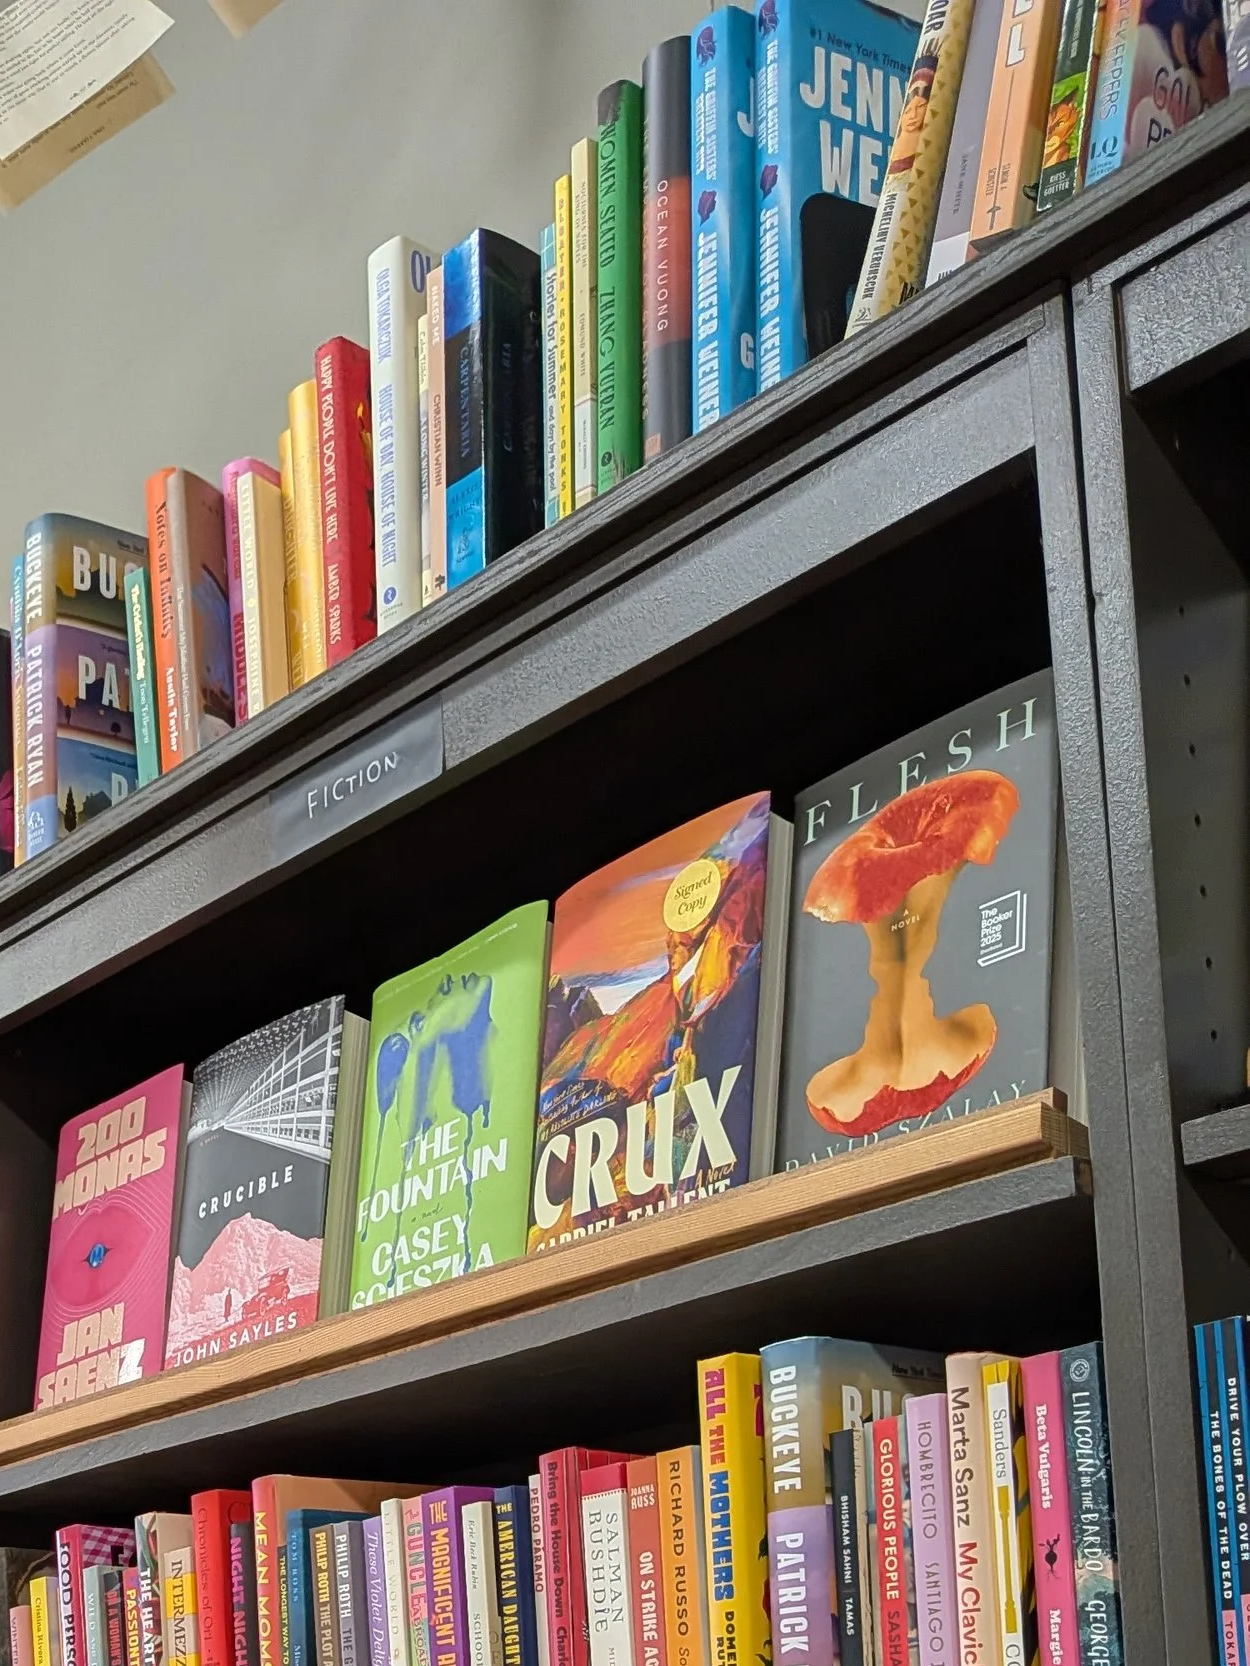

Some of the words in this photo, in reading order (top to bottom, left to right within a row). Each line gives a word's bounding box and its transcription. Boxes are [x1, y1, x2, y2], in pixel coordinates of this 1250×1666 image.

[657, 180, 667, 249] OCEAN
[658, 257, 668, 332] VUONG
[156, 501, 168, 551] Notes
[159, 552, 168, 572] on
[159, 577, 171, 638] Infinity
[166, 667, 177, 707] Austin
[167, 710, 178, 751] Taylor
[306, 751, 398, 818] FICTION
[804, 698, 1038, 845] FLESH
[673, 873, 713, 900] Signed
[678, 896, 707, 916] Copy
[981, 908, 998, 919] The
[891, 914, 920, 932] NOVEL
[980, 931, 1002, 947] 2025
[981, 910, 1013, 928] Booker
[981, 924, 1002, 938] Prize
[78, 1096, 144, 1155] 200
[402, 1120, 461, 1170] THE
[533, 1064, 743, 1229] CRUX
[55, 1130, 169, 1218] MONAS
[198, 1165, 294, 1219] CRUCIBLE
[358, 1140, 508, 1231] FOUNTAIN
[372, 1215, 466, 1275] CASEY
[58, 1304, 124, 1366] JAN
[174, 1336, 221, 1368] JOHN
[229, 1311, 298, 1349] SAYLES
[39, 1340, 145, 1409] SAENZ
[704, 1369, 725, 1419] ALL
[1228, 1377, 1238, 1420] DRIVE
[708, 1425, 725, 1465] THE
[769, 1364, 801, 1494] BUCKEYE
[950, 1386, 971, 1463] Marta
[992, 1408, 1007, 1479] Sanders
[1035, 1404, 1048, 1440] Beta
[1210, 1411, 1220, 1438] THE
[1232, 1428, 1243, 1467] YOUR
[880, 1439, 896, 1531] GLORIOUS
[1037, 1442, 1051, 1509] Vulgaris
[1213, 1444, 1224, 1493] BONES
[1235, 1473, 1247, 1514] PLOW
[669, 1461, 684, 1556] RICHARD
[953, 1467, 974, 1528] Sanz
[1217, 1501, 1226, 1519] OF
[254, 1511, 269, 1585] MEAN
[709, 1471, 734, 1601] MOTHERS
[959, 1542, 975, 1582] My
[1219, 1526, 1229, 1554] THE
[1239, 1522, 1250, 1561] OVER
[140, 1568, 151, 1603] THE
[776, 1532, 810, 1654] PATRICK
[884, 1536, 899, 1600] PEOPLE
[1221, 1561, 1232, 1600] DEAD
[675, 1566, 688, 1636] RUSSO
[142, 1607, 155, 1665] HEART
